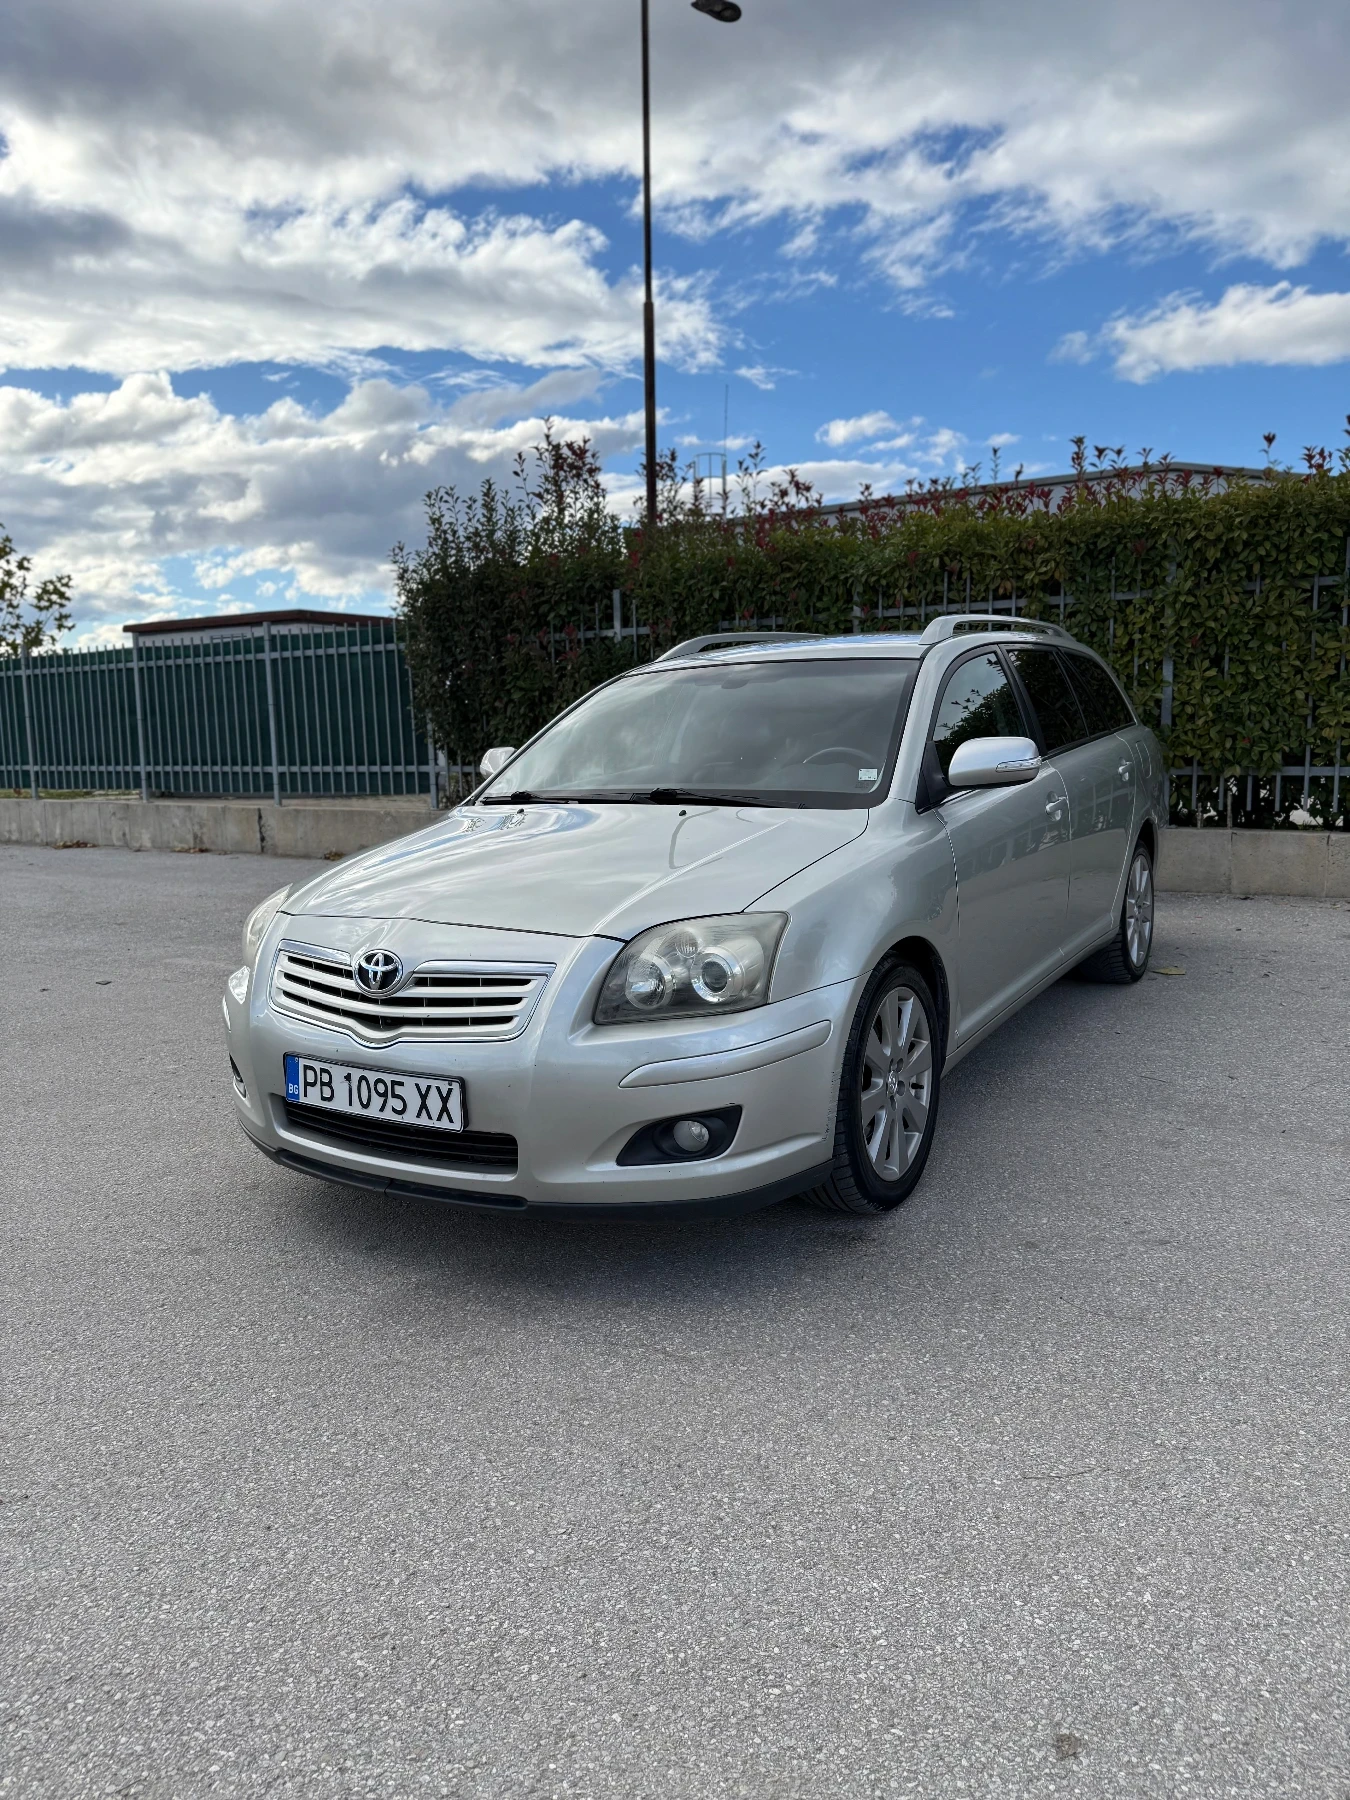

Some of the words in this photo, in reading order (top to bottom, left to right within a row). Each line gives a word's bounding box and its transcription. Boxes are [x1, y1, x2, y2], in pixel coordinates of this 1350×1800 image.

[288, 1083, 299, 1095] BG
[303, 1064, 334, 1102] PB
[343, 1072, 407, 1116] 1095
[414, 1082, 455, 1124] XX
